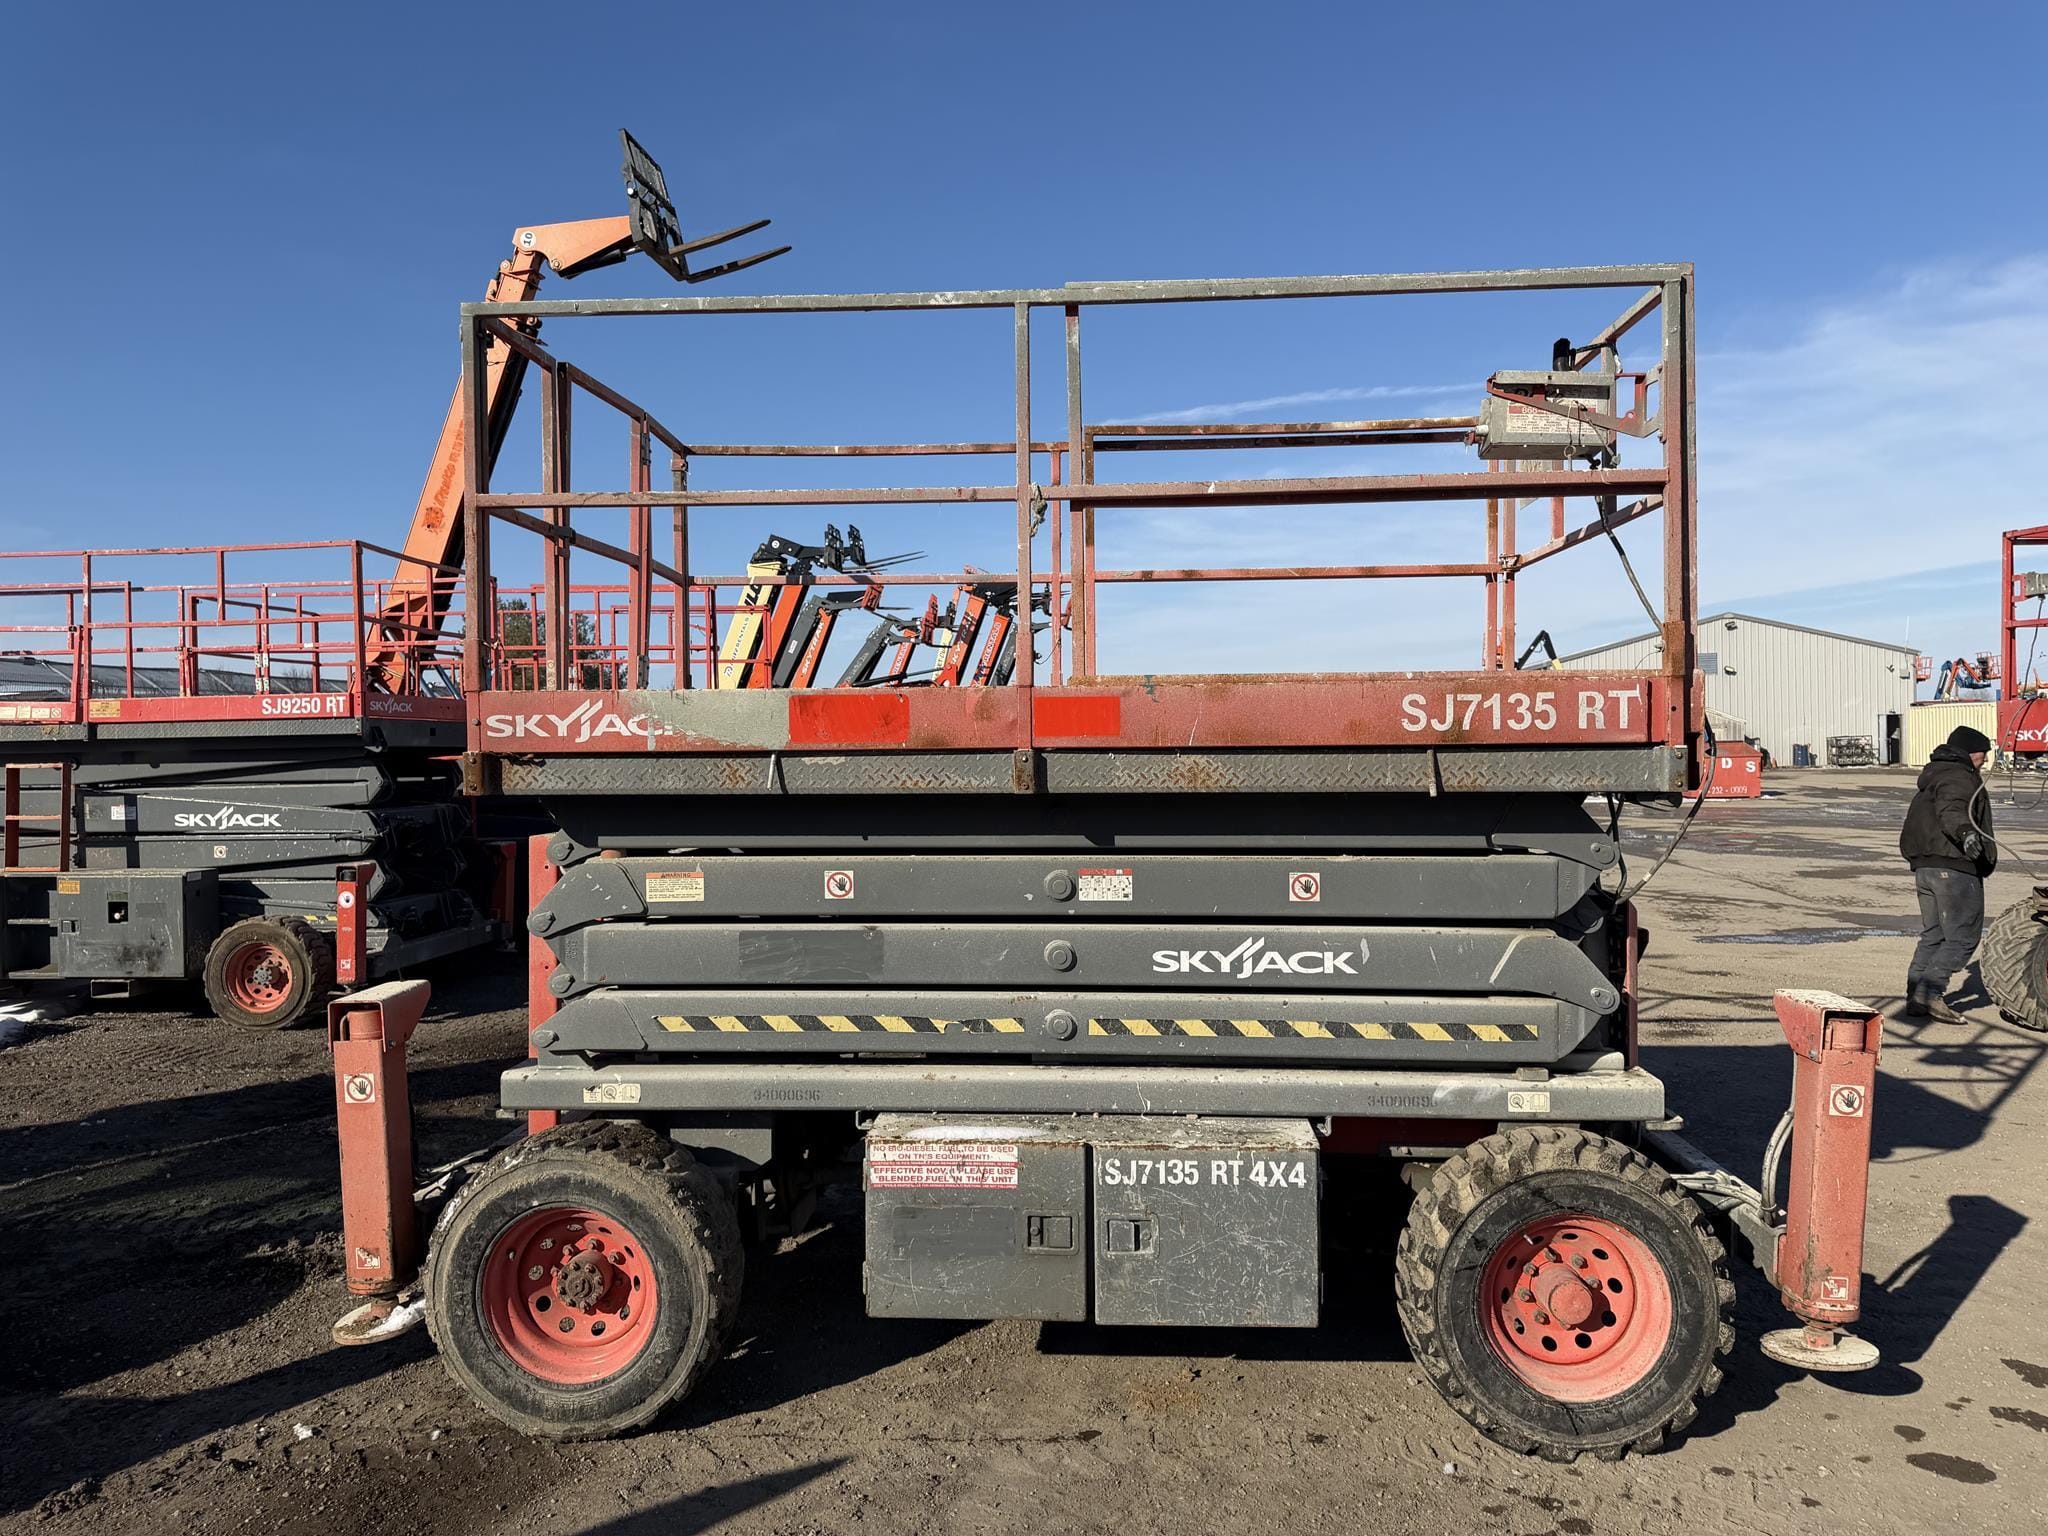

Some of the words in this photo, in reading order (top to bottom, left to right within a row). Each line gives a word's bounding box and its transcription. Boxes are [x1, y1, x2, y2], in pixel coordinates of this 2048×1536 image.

[523, 232, 533, 246] 10
[801, 621, 825, 675] SKYTRAK
[262, 697, 321, 715] SJ9250
[326, 696, 346, 714] RT
[369, 697, 413, 714] SKYJACK
[1401, 691, 1557, 732] SJ7135
[1578, 688, 1640, 730] RT
[486, 698, 673, 743] SKYJAC
[2015, 723, 2048, 743] SKY
[174, 805, 282, 830] SKYJACK
[1152, 936, 1359, 979] SKYJACK
[976, 1145, 989, 1153] BE
[957, 1167, 995, 1175] PLEASE
[1104, 1158, 1200, 1187] SJ7135
[1211, 1159, 1244, 1186] RT
[1249, 1160, 1308, 1189] 4X4
